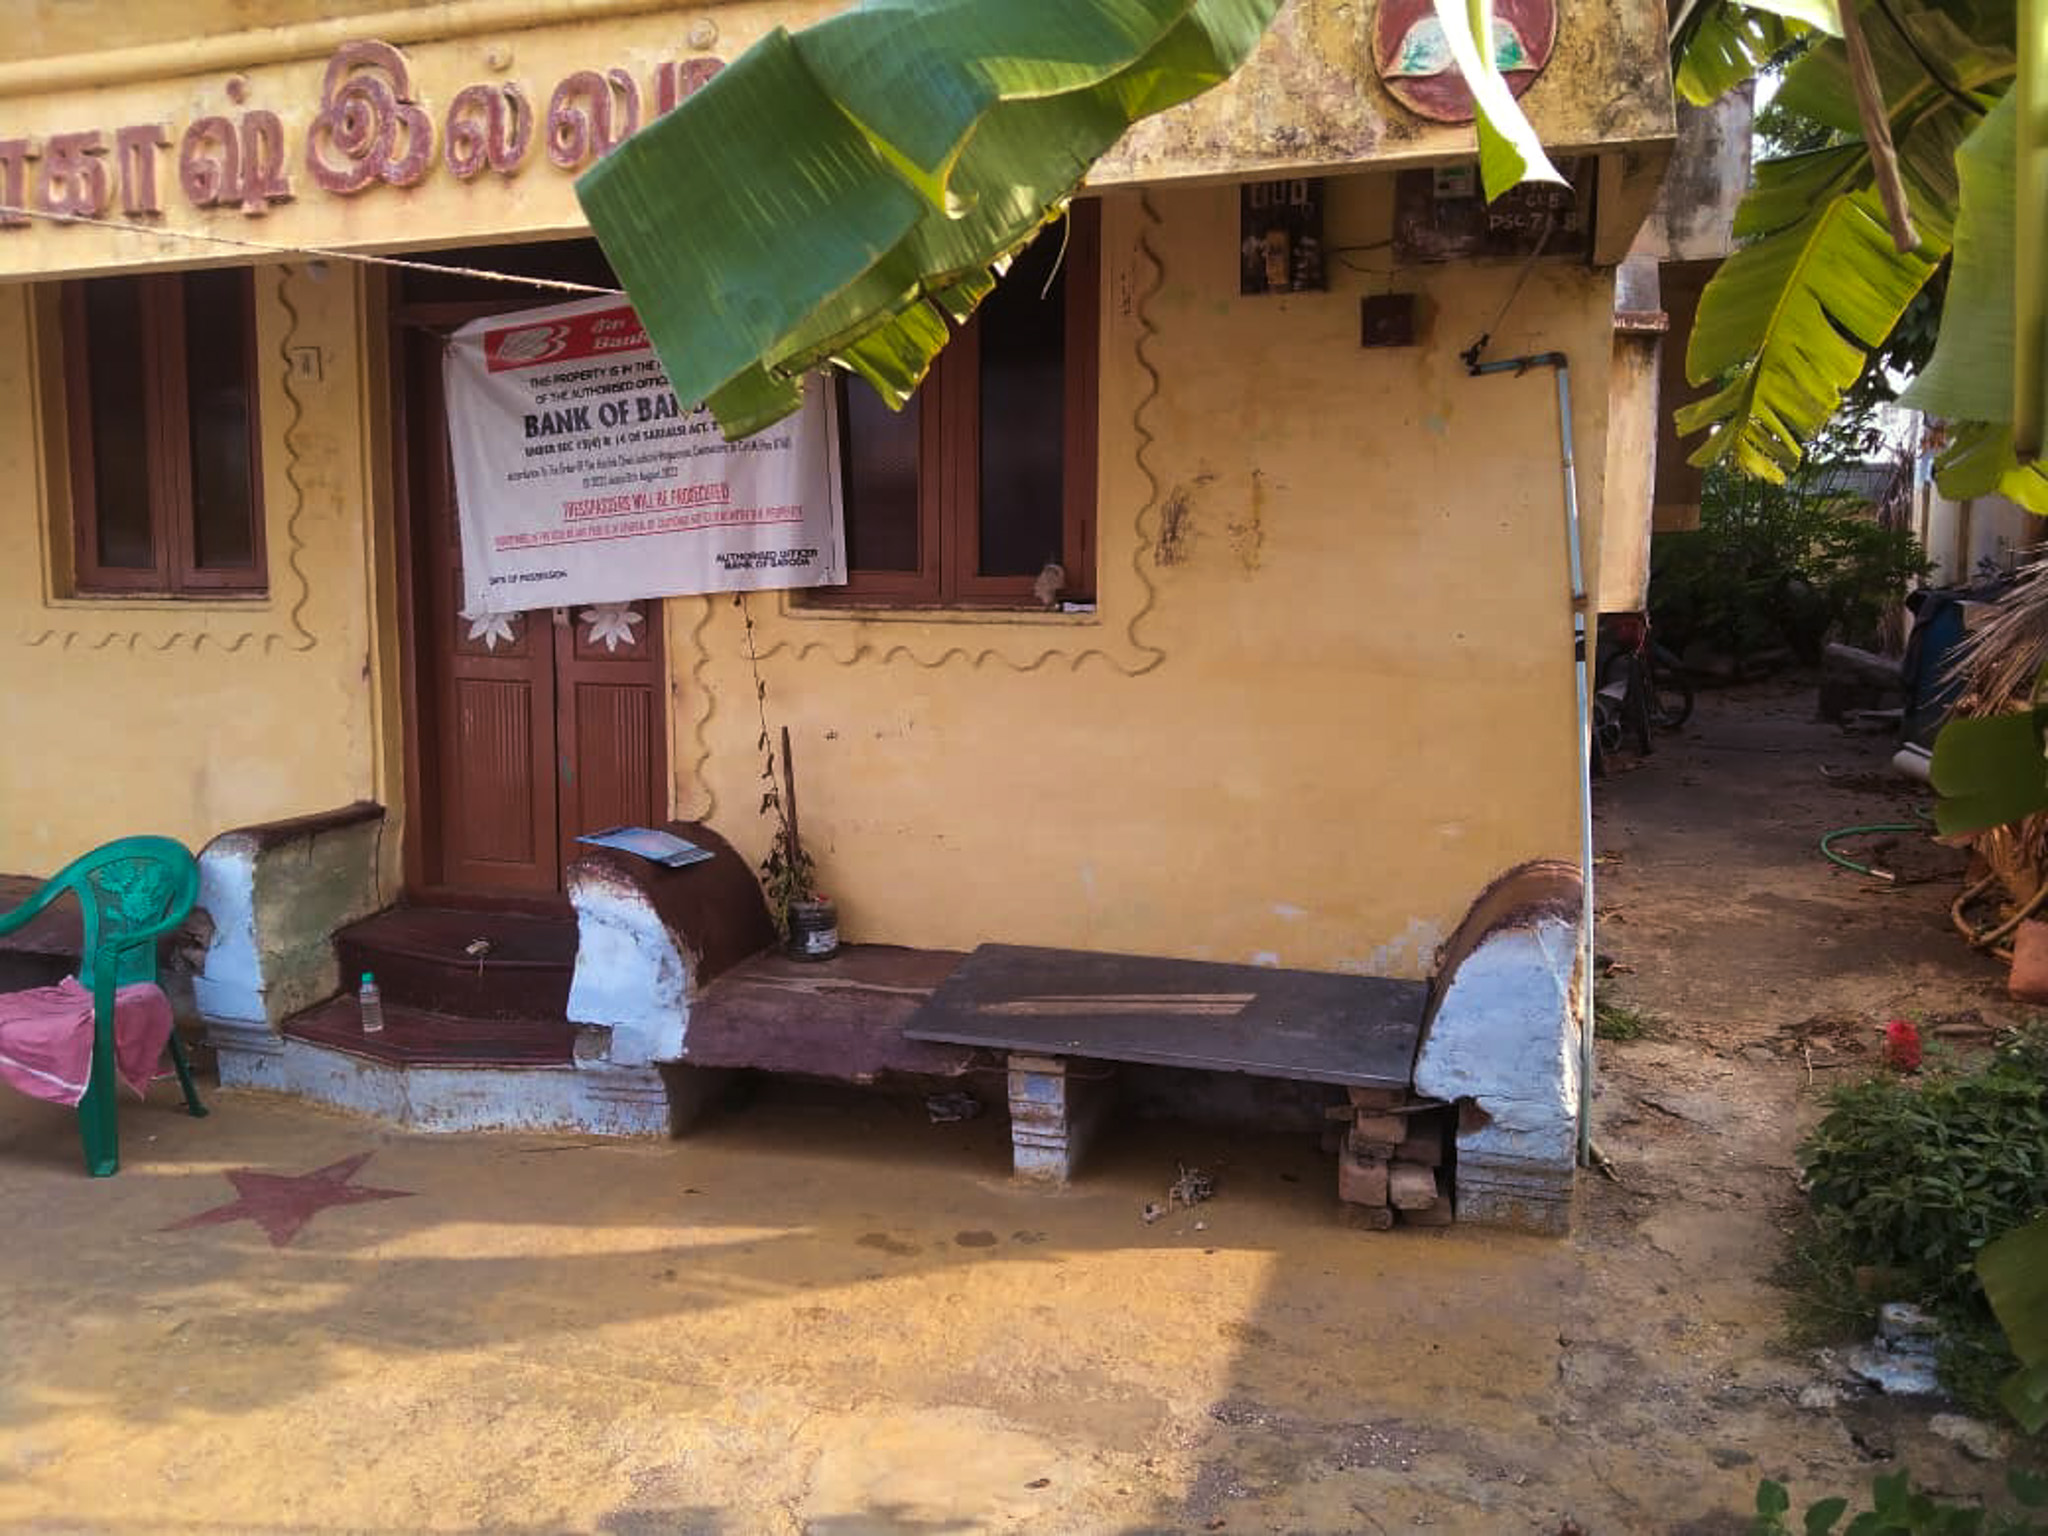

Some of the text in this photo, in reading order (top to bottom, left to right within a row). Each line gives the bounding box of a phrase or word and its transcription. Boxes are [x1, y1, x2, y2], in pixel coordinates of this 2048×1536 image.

[635, 374, 670, 390] OFFIC
[524, 405, 591, 438] BANK
[598, 398, 630, 428] OF
